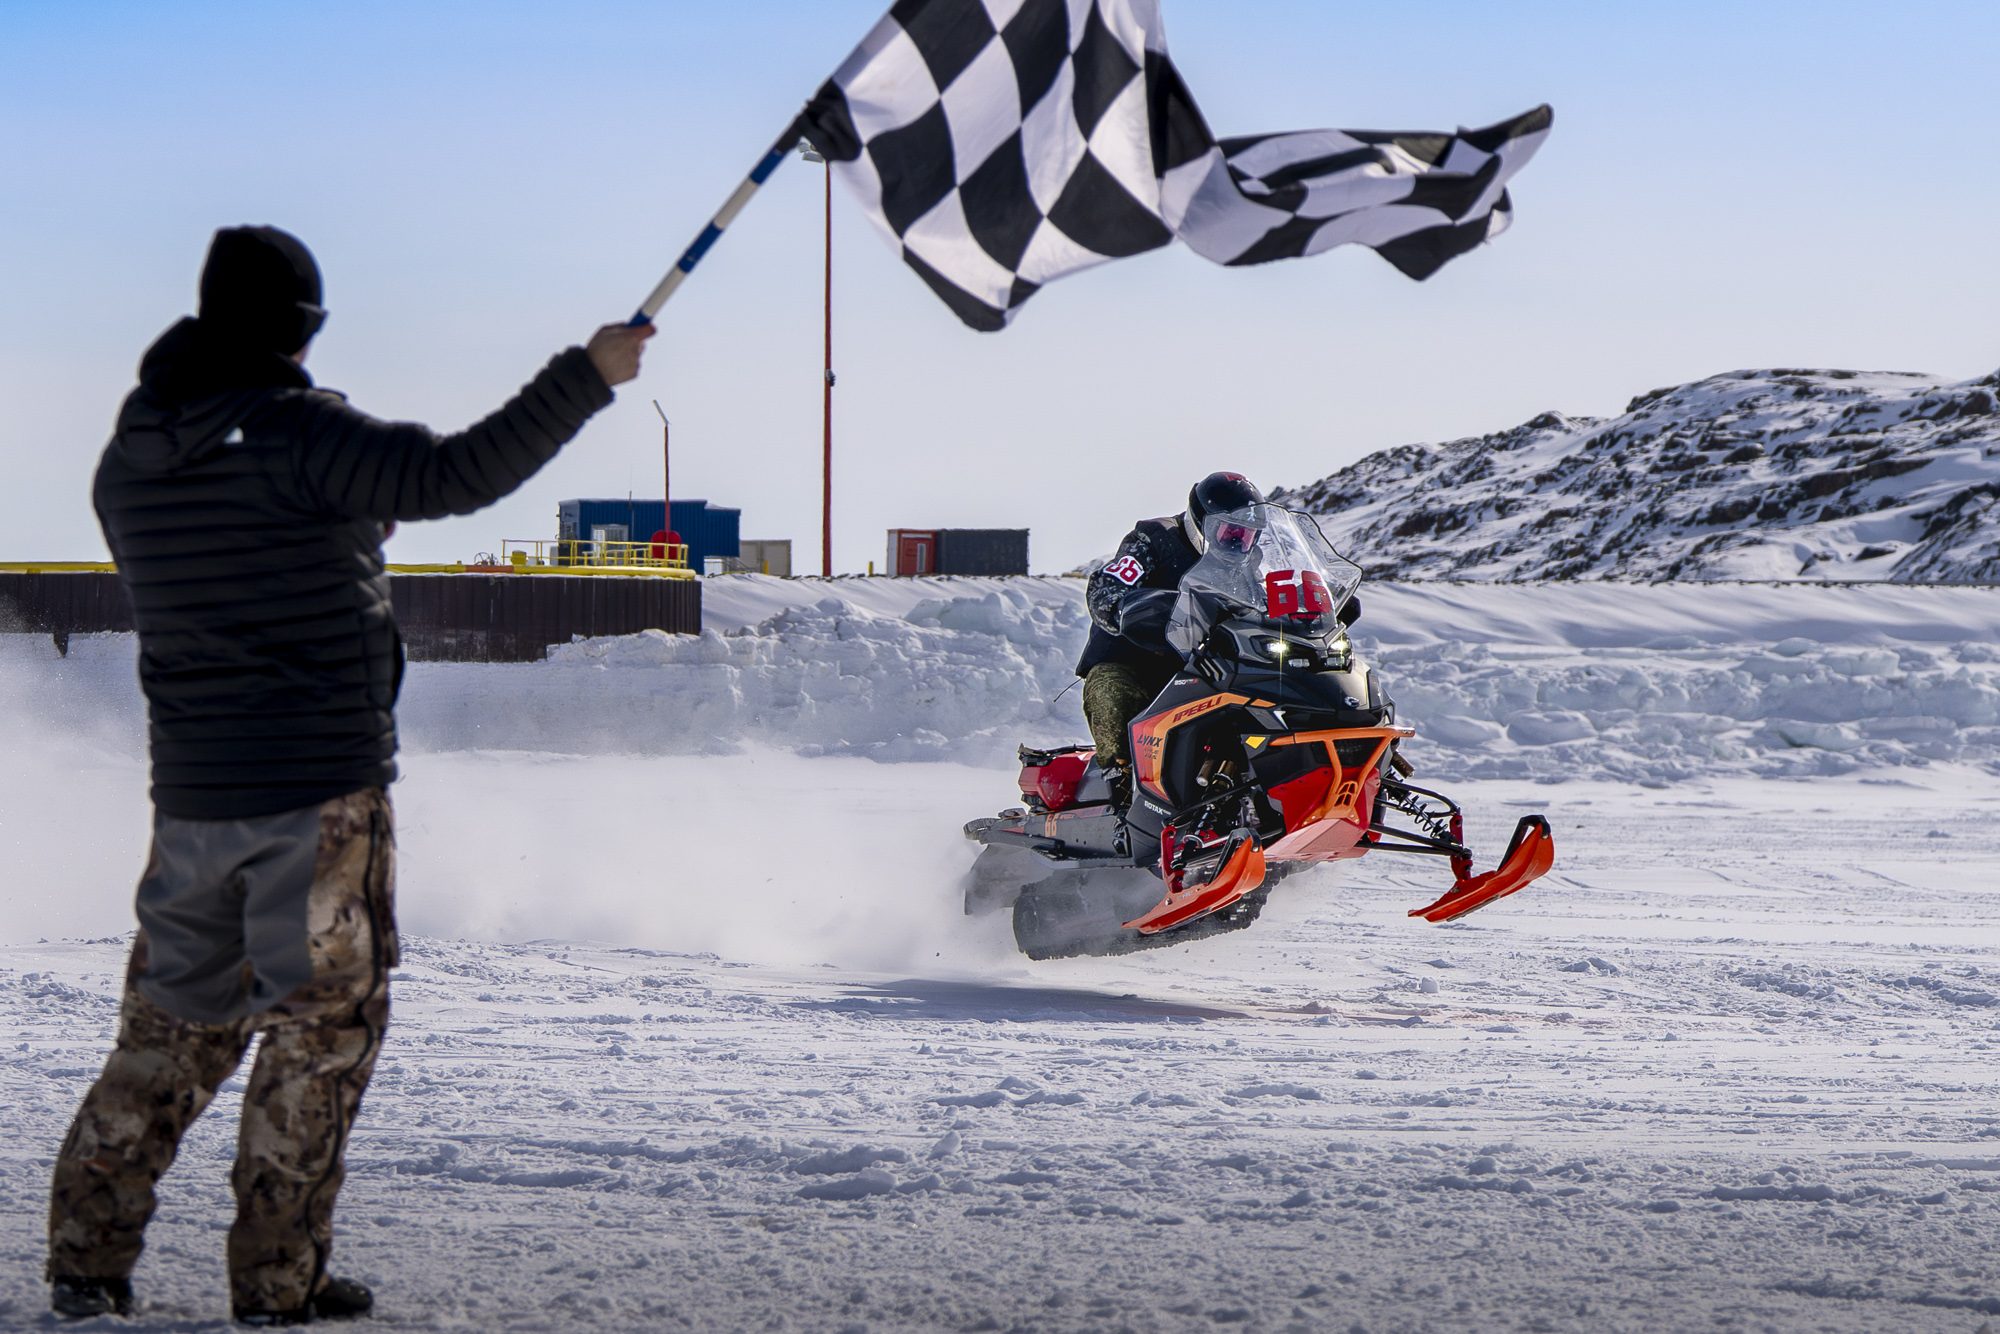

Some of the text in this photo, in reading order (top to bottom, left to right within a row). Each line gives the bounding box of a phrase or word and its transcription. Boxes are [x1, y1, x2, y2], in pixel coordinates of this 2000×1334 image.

[1265, 569, 1334, 619] 66
[1136, 734, 1163, 748] LYNX
[1144, 800, 1163, 815] ROTAX
